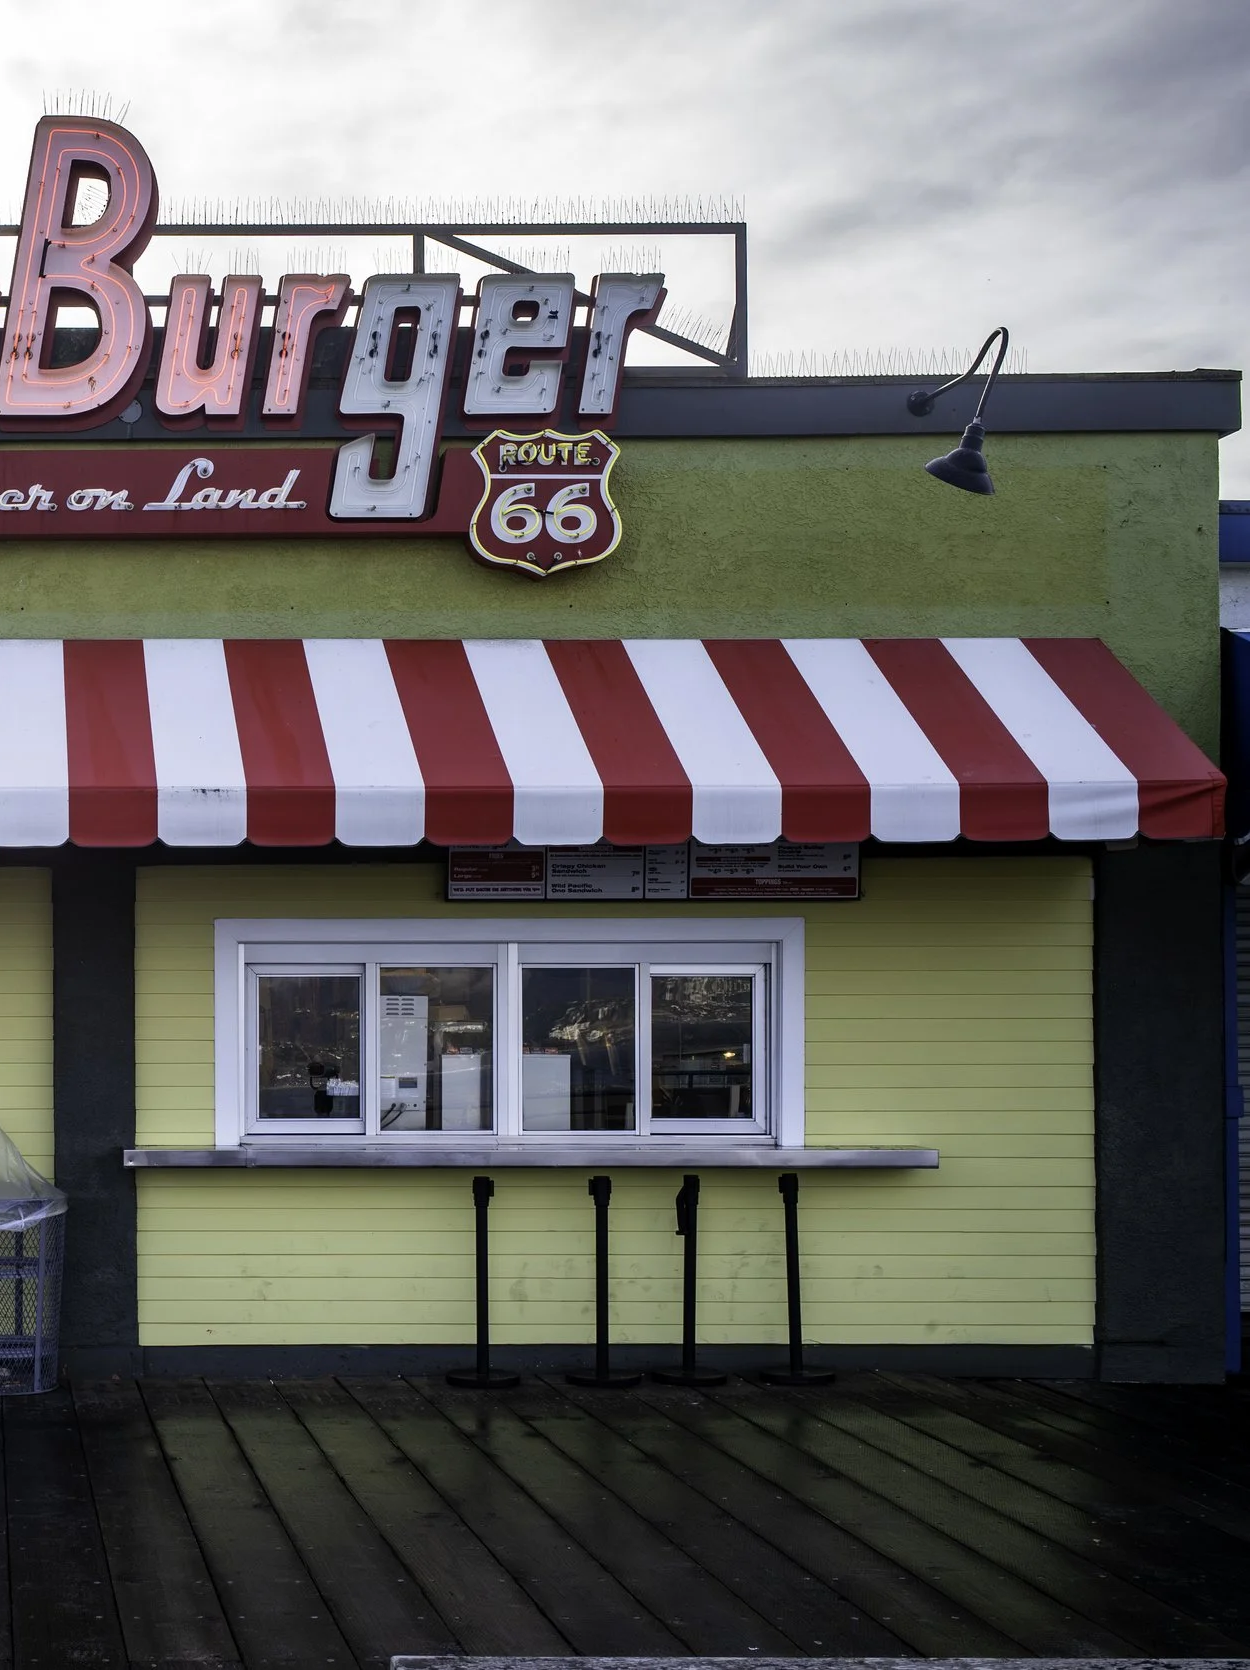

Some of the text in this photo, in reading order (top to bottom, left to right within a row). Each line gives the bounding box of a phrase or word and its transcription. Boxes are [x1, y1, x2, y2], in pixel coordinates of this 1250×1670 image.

[499, 442, 593, 467] ROUTE
[66, 487, 134, 513] on
[142, 457, 307, 511] Land
[490, 482, 598, 544] 66
